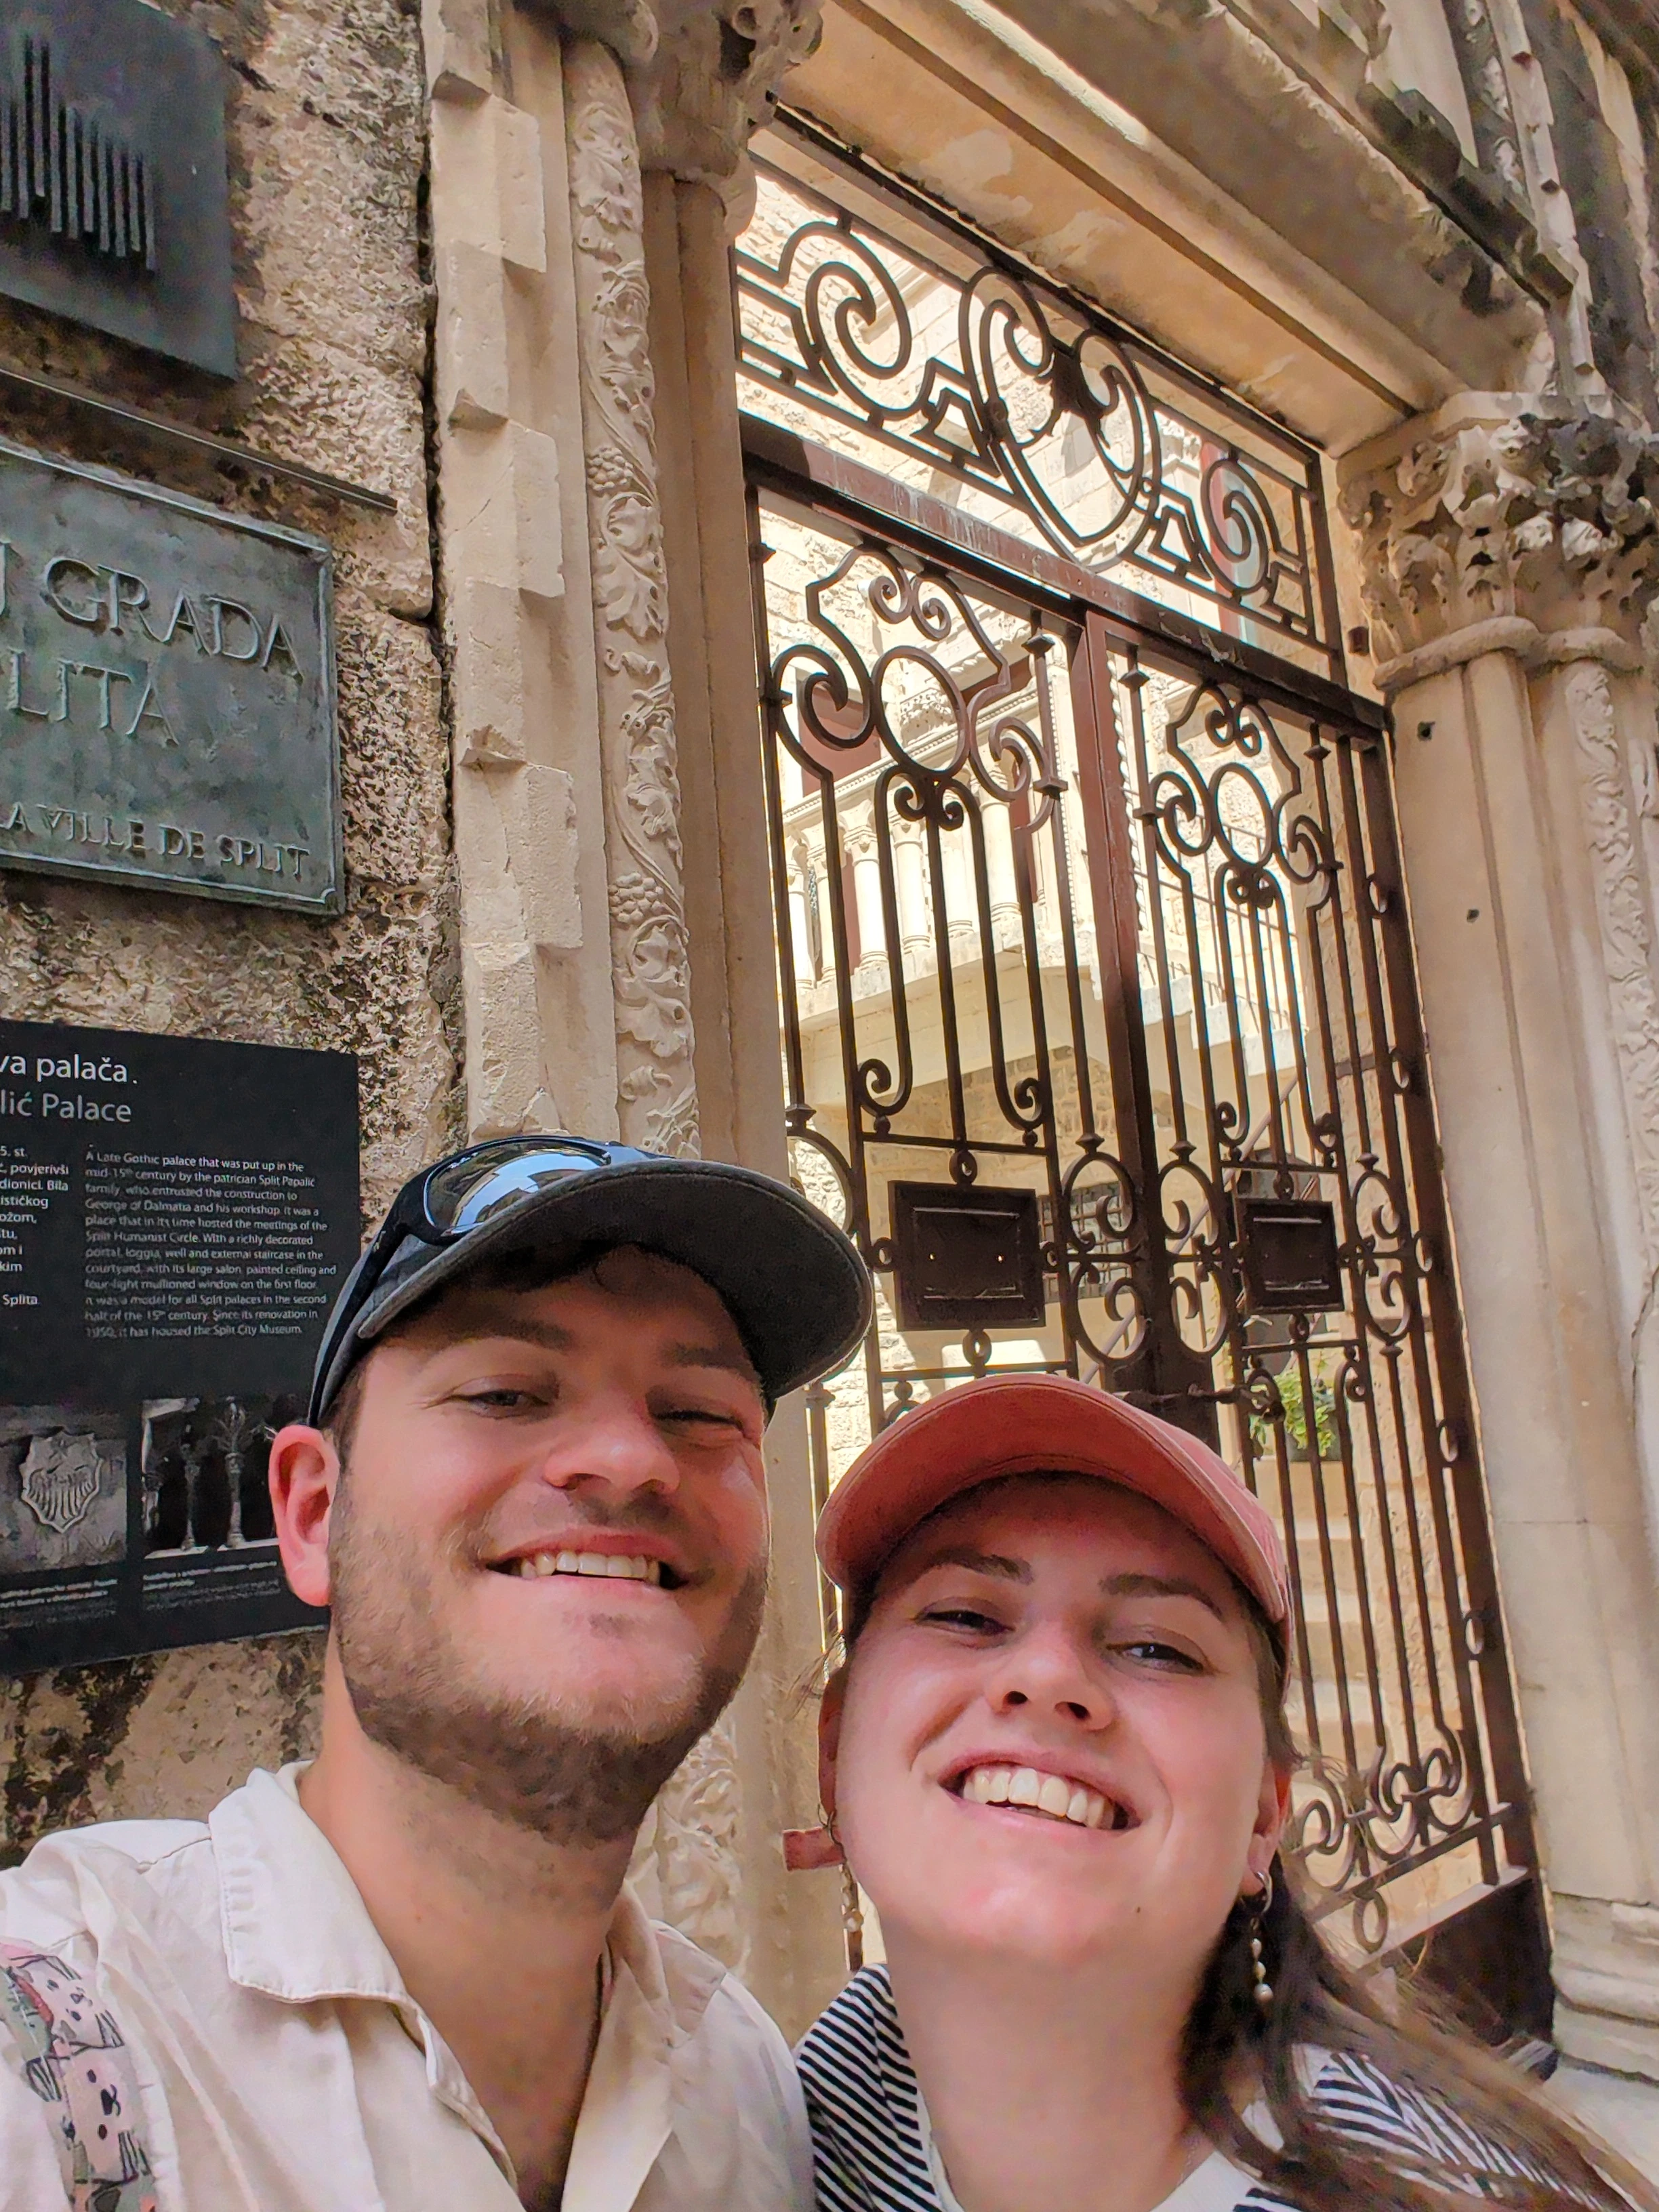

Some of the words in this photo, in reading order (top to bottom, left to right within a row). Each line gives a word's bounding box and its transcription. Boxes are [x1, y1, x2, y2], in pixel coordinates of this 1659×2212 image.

[42, 556, 304, 684] GRADA
[6, 646, 179, 746] LITA
[36, 803, 149, 851] VILLE
[158, 823, 204, 859] DE
[215, 834, 310, 879] SPLIT
[42, 1092, 132, 1123] Palace
[9, 1162, 69, 1176] povjerivši
[85, 1153, 94, 1162] A
[96, 1153, 121, 1162] Late
[123, 1153, 160, 1164] Gothic
[163, 1155, 197, 1167] palace
[199, 1156, 220, 1167] that
[221, 1160, 241, 1169] was
[243, 1161, 260, 1171] put
[262, 1163, 276, 1172] up
[277, 1162, 286, 1170] in
[288, 1162, 304, 1172] the
[47, 1179, 69, 1191] Bila
[136, 1170, 177, 1183] century
[179, 1171, 193, 1183] by
[194, 1172, 212, 1182] the
[213, 1174, 257, 1185] patrician
[259, 1174, 281, 1187] Split
[282, 1176, 316, 1188] Papalić
[125, 1185, 150, 1195] who
[152, 1187, 203, 1197] entrusted
[205, 1187, 222, 1198] the
[224, 1189, 285, 1201] construction
[287, 1191, 298, 1201] to
[85, 1197, 128, 1212] George
[129, 1200, 142, 1210] of
[144, 1200, 192, 1212] Dalmatia
[193, 1203, 214, 1213] and
[216, 1203, 230, 1214] his
[293, 1208, 312, 1216] was
[313, 1208, 319, 1216] a
[85, 1214, 115, 1227] place
[119, 1216, 142, 1227] that
[144, 1216, 155, 1227] in
[157, 1216, 170, 1228] its
[171, 1218, 197, 1228] time
[198, 1217, 233, 1229] hosted
[235, 1218, 252, 1229] the
[253, 1221, 298, 1233] meetings
[300, 1221, 310, 1231] of
[312, 1221, 328, 1231] the
[113, 1231, 167, 1243] Humanist
[237, 1234, 263, 1246] richly
[265, 1234, 314, 1246] decorated
[165, 1248, 187, 1258] well
[188, 1249, 209, 1259] and
[211, 1250, 252, 1260] external
[253, 1250, 294, 1261] staircase
[296, 1250, 306, 1261] in
[308, 1250, 324, 1261] the
[146, 1263, 170, 1273] with
[172, 1265, 185, 1274] its
[186, 1264, 213, 1277] large
[247, 1265, 283, 1275] painted
[285, 1265, 316, 1277] ceiling
[319, 1265, 337, 1275] and
[140, 1278, 197, 1290] mullioned
[197, 1279, 238, 1290] window
[240, 1280, 254, 1290] on
[256, 1279, 272, 1289] the
[129, 1294, 167, 1305] model
[167, 1295, 183, 1305] for
[185, 1294, 198, 1304] all
[199, 1295, 223, 1306] Split
[224, 1294, 262, 1306] palaces
[263, 1295, 273, 1304] in
[274, 1294, 291, 1305] the
[292, 1294, 327, 1305] second
[108, 1309, 122, 1321] of
[123, 1311, 143, 1321] the
[212, 1309, 240, 1322] Since
[241, 1310, 253, 1320] its
[254, 1310, 307, 1321] renovation
[308, 1309, 319, 1319] in
[129, 1326, 148, 1337] has
[151, 1325, 191, 1337] housed
[193, 1325, 212, 1335] the
[213, 1324, 236, 1336] Split
[237, 1324, 258, 1337] City
